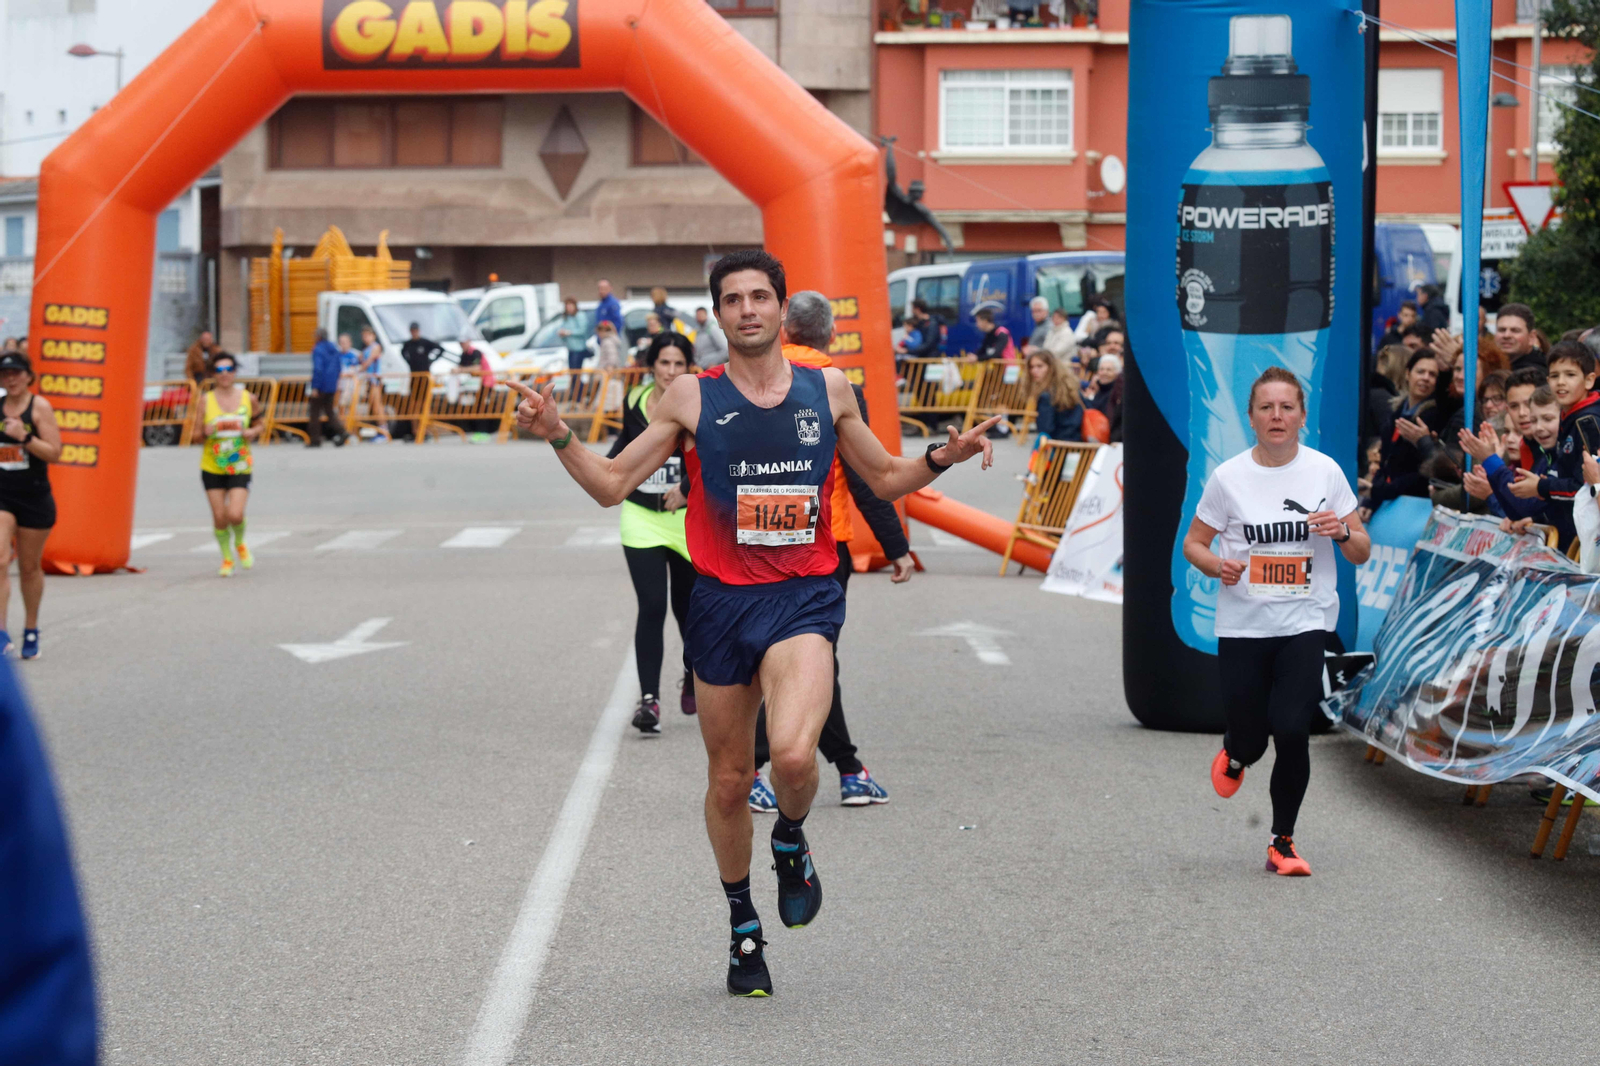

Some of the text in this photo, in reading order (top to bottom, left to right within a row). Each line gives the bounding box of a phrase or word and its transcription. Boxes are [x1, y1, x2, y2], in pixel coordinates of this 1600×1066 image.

[331, 0, 572, 61] GADIS
[1182, 203, 1330, 229] POWERADE
[44, 304, 108, 327] GADIS
[829, 298, 858, 316] DIS
[42, 340, 105, 361] GADIS
[828, 332, 862, 354] DIS
[39, 375, 103, 396] GADIS
[53, 410, 100, 431] ADIS
[59, 444, 98, 465] DIS
[729, 459, 813, 477] RUNMANIAK
[755, 505, 797, 529] 1145
[1243, 521, 1310, 545] PUMA
[1263, 563, 1296, 584] 1109
